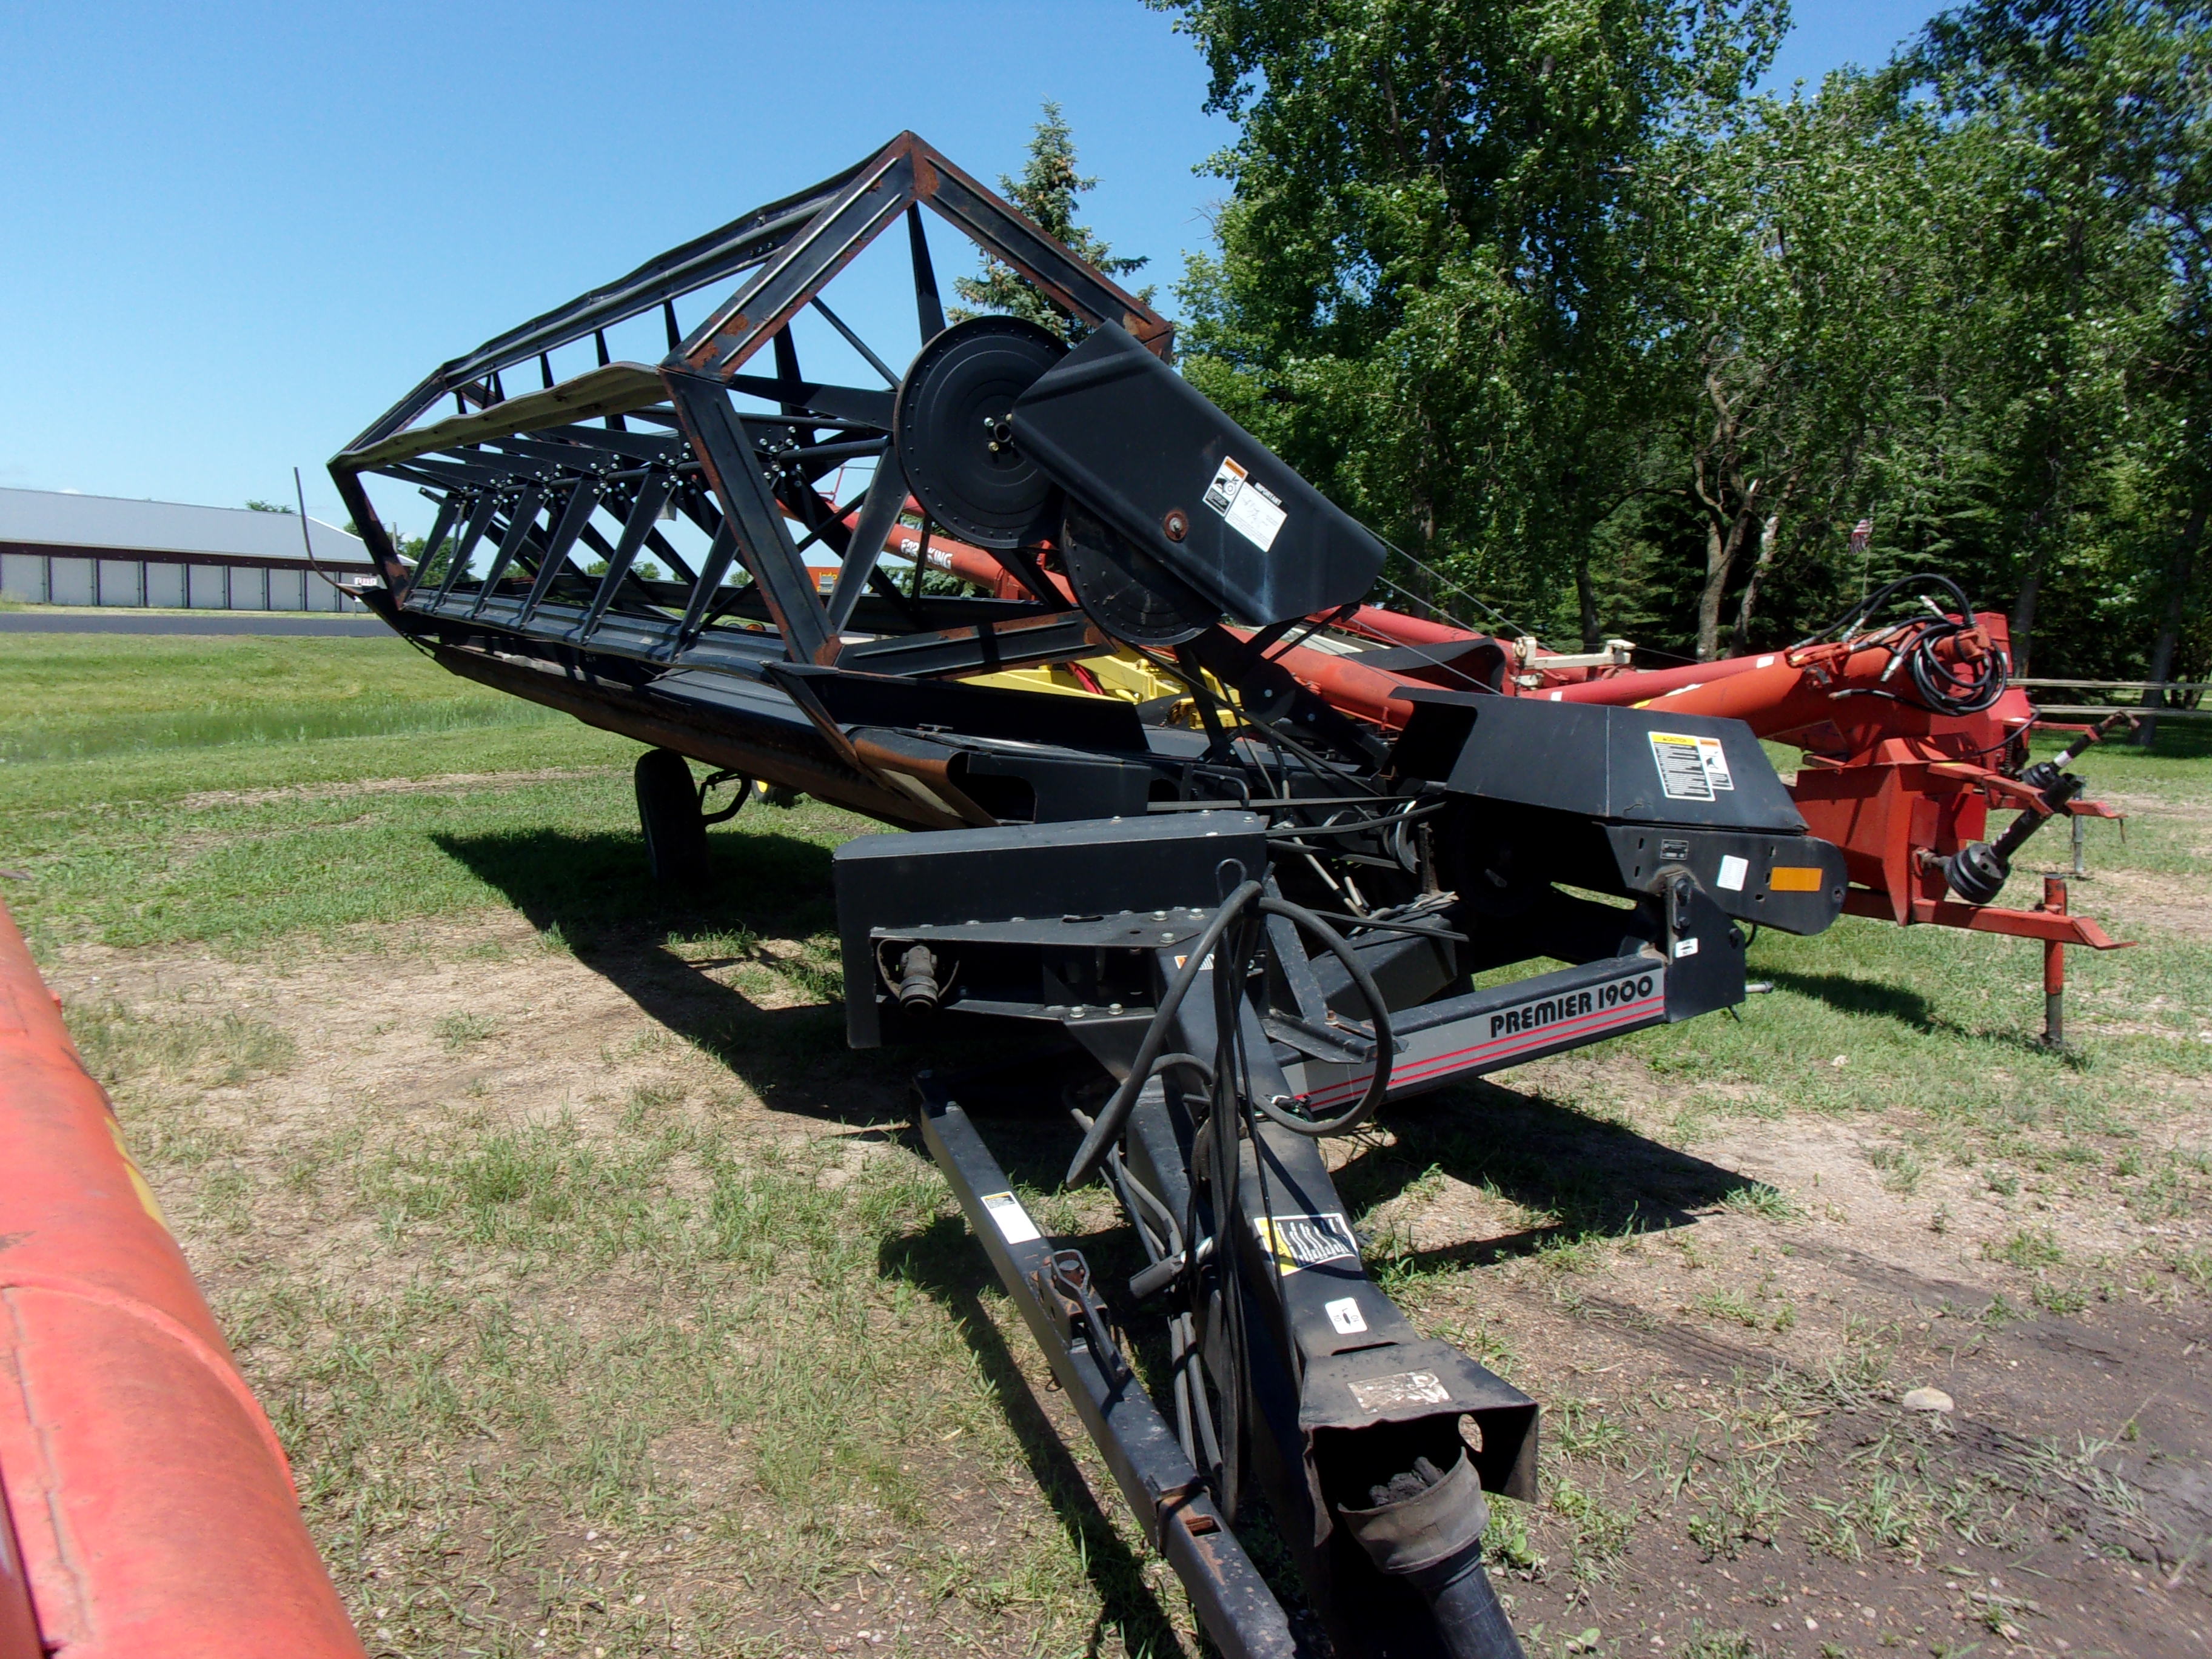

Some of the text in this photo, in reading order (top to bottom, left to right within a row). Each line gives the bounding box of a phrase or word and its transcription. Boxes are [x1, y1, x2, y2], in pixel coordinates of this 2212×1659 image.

[1255, 482, 1282, 506] IMPORTANT
[901, 538, 953, 569] FAR KING
[1490, 976, 1654, 1038] PREMIER 1900
